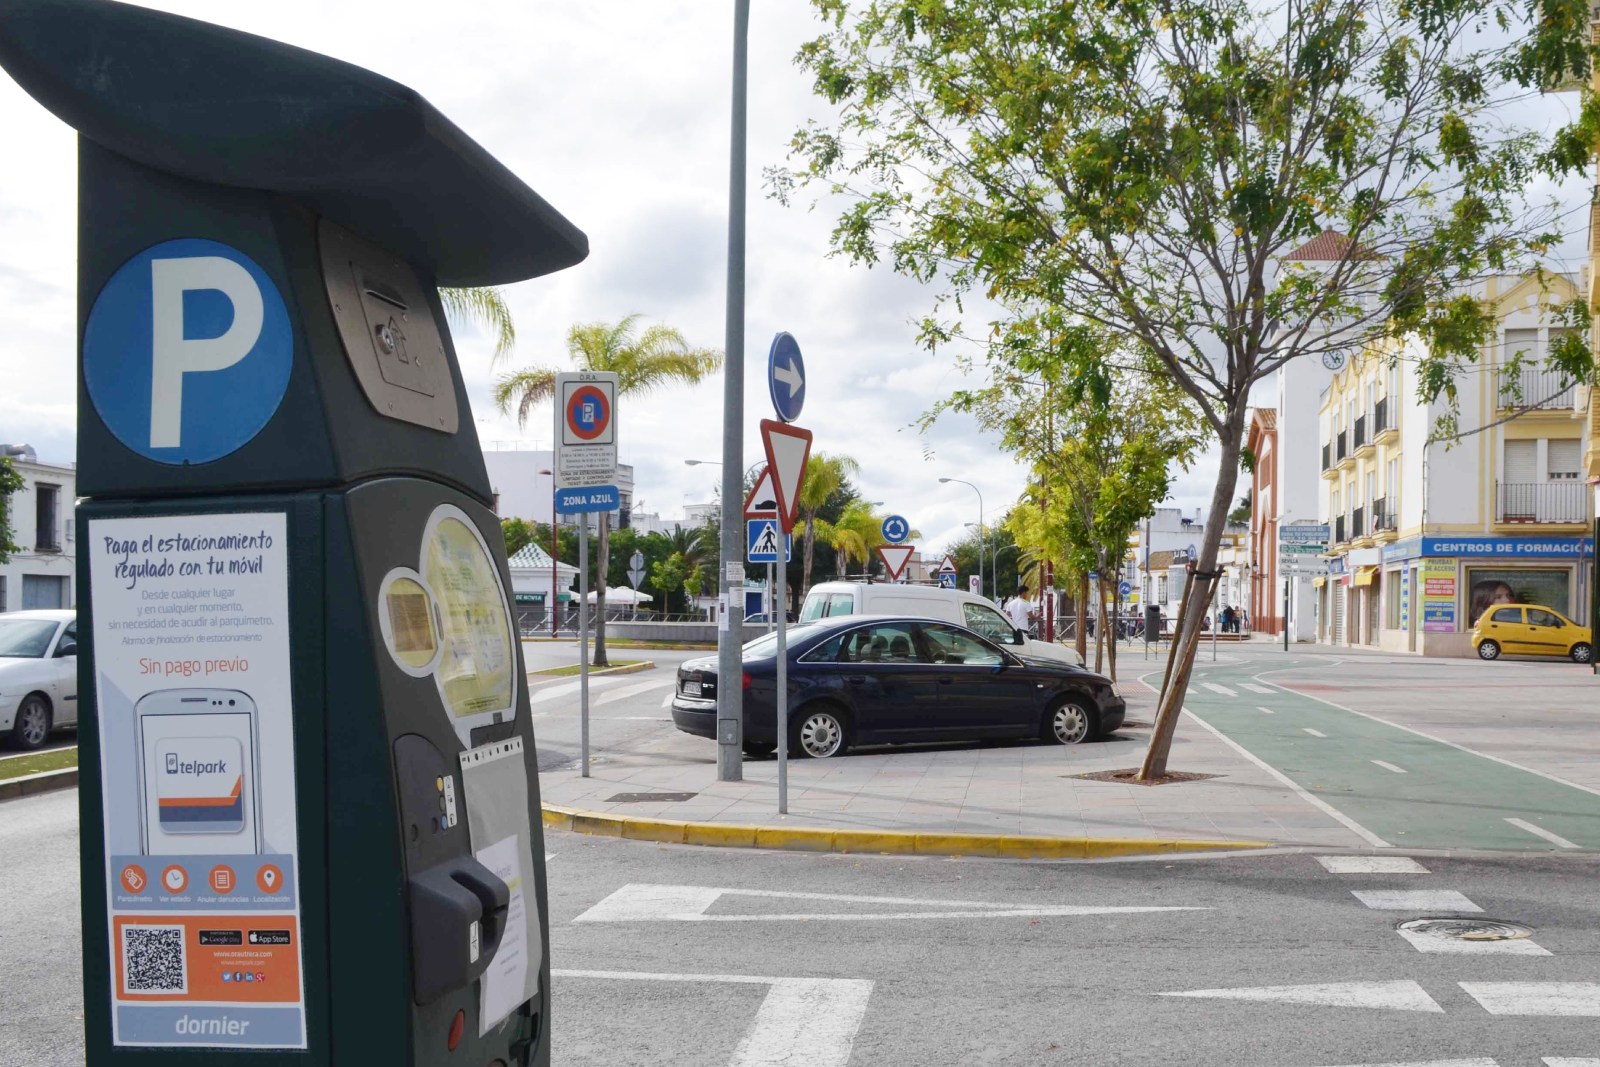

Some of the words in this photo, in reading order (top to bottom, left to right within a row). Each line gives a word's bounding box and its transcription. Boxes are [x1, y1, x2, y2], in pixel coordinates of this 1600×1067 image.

[150, 256, 264, 448] P
[564, 496, 587, 506] ZONA
[590, 494, 613, 504] AZUL
[104, 536, 138, 564] Paga
[143, 535, 153, 553] el
[158, 530, 273, 553] estacionamiento
[1434, 544, 1493, 553] CENTROS
[1497, 544, 1513, 553] DE
[115, 558, 175, 590] regulado
[179, 562, 204, 576] con
[207, 556, 225, 575] tu
[229, 556, 263, 575] móvil
[142, 590, 169, 600] Desde
[171, 589, 211, 601] cualquier
[214, 589, 236, 600] lugar
[137, 606, 143, 616] y
[145, 606, 156, 614] en
[158, 603, 198, 615] cualquier
[200, 603, 244, 613] momento,
[109, 620, 121, 630] sin
[123, 619, 166, 629] necesidad
[168, 618, 179, 627] de
[182, 617, 207, 626] acudir
[210, 617, 218, 626] al
[139, 658, 162, 674] Sin
[166, 660, 201, 677] pago
[206, 656, 249, 676] previo
[180, 760, 227, 777] telpark
[209, 935, 227, 945] Google
[258, 936, 272, 944] App
[175, 1015, 250, 1036] dornier
